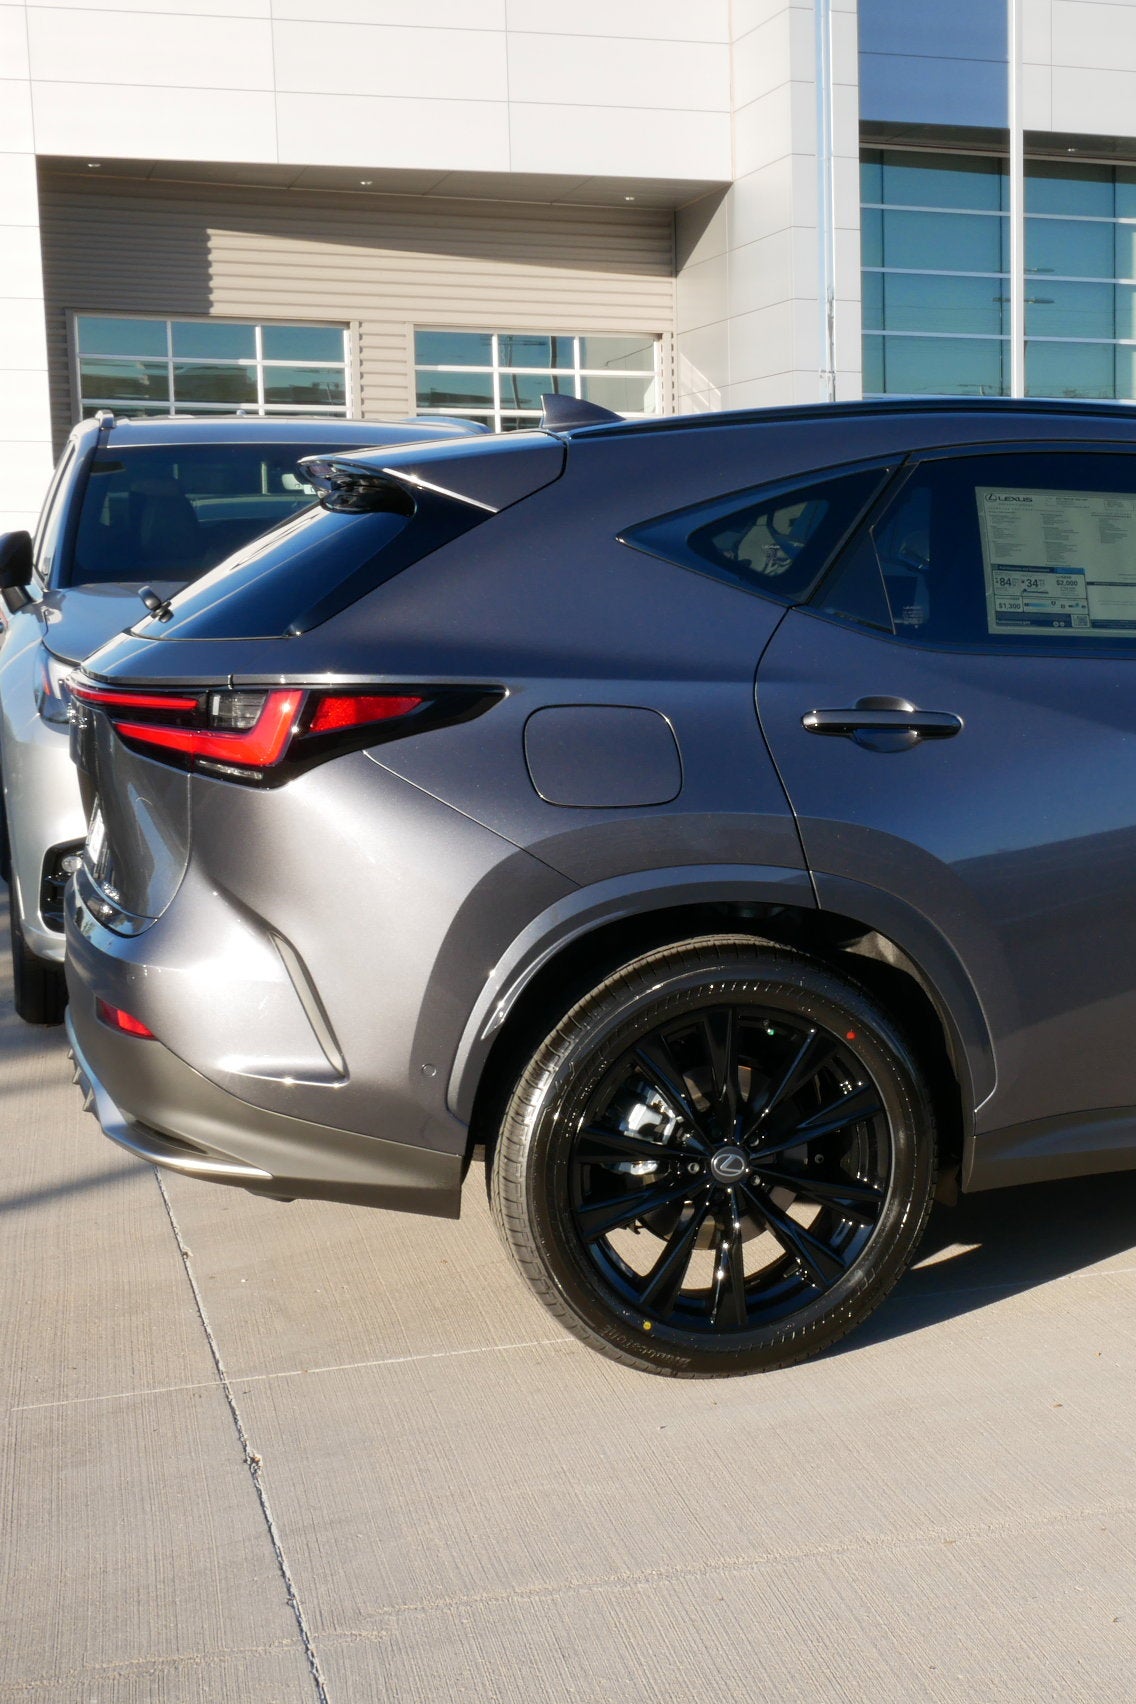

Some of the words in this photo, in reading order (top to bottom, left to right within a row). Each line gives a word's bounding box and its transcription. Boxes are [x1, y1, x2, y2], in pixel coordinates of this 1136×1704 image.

[998, 495, 1033, 503] LEXUS
[999, 577, 1012, 587] 84
[1026, 578, 1039, 588] 34
